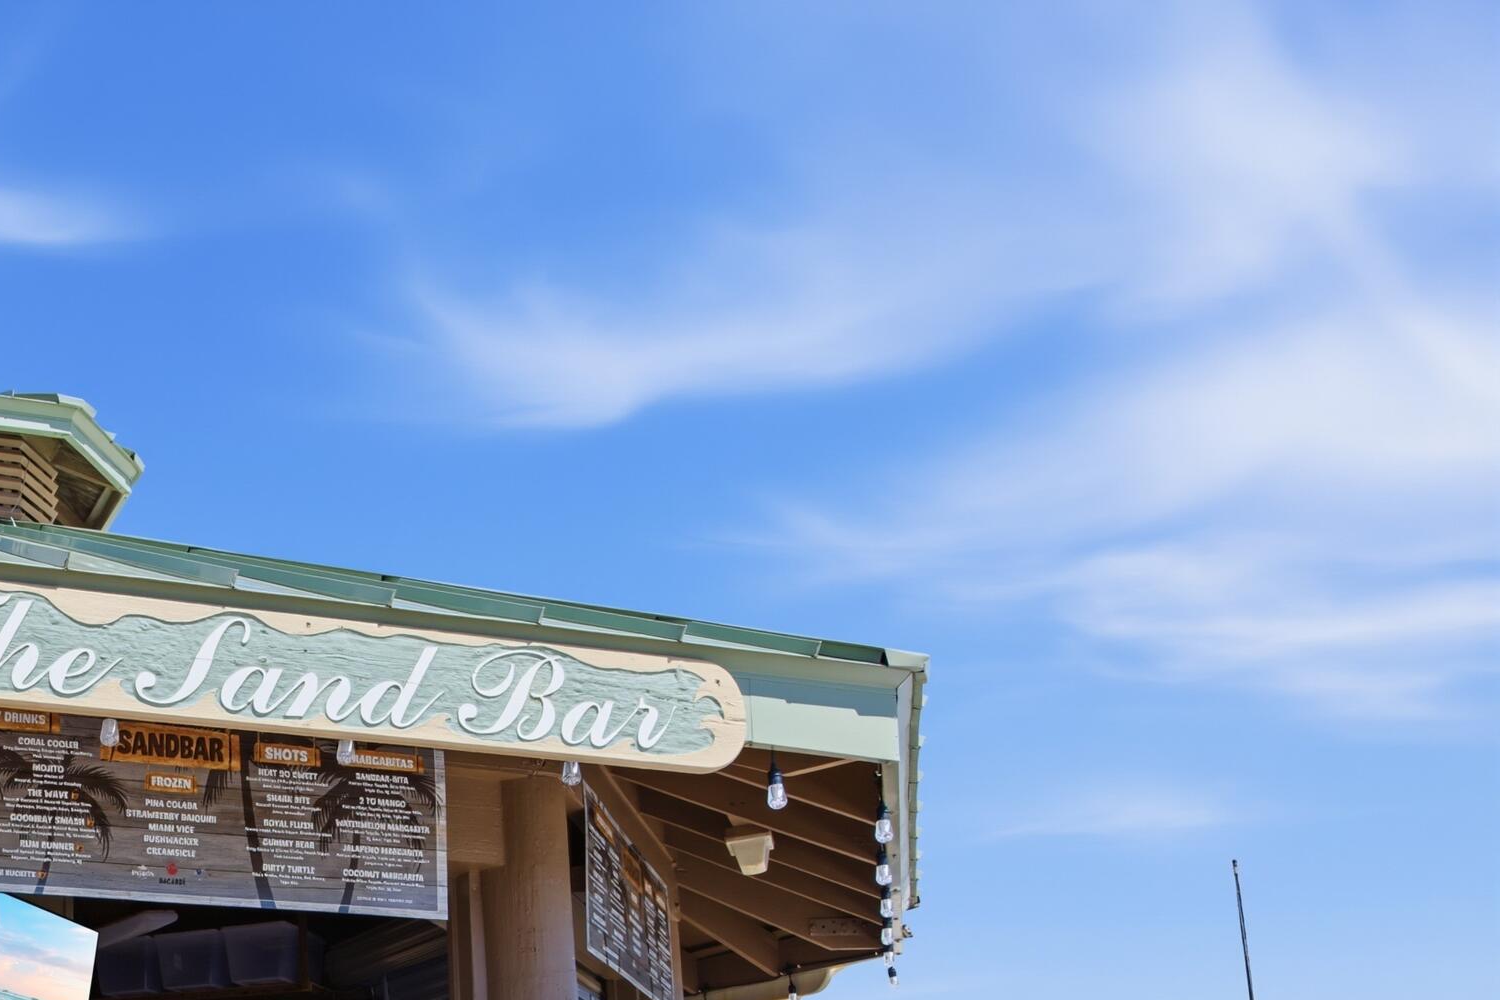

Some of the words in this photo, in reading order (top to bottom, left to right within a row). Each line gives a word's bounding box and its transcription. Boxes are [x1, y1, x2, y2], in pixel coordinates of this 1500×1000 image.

[135, 617, 445, 728] Sand
[458, 649, 676, 750] Bar
[4, 711, 46, 726] DRINKS
[18, 737, 45, 746] CORAL
[47, 740, 79, 749] COOLER
[117, 729, 224, 762] SANDBAR
[264, 746, 308, 763] SHOTS
[32, 763, 65, 773] MOJITO
[151, 776, 192, 789] FROZEN
[28, 789, 43, 797] THE
[44, 790, 69, 799] WAVE
[266, 794, 293, 803] SHARK
[294, 796, 311, 805] BITE
[166, 800, 198, 810] COLADA
[378, 799, 406, 808] MANGO
[126, 809, 179, 821] STRAWBERRY
[55, 816, 85, 826] SMASH
[263, 819, 289, 829] ROYAL
[290, 820, 314, 830] FLUSH
[335, 819, 387, 831] WATERMELON
[148, 823, 175, 833] MIAMI
[177, 825, 196, 834] VICE
[20, 840, 39, 849] RUM
[41, 841, 75, 851] RUNNER
[144, 835, 199, 847] BUSHWACKER
[262, 838, 294, 848] GUMMY
[295, 841, 315, 849] BEAR
[147, 847, 197, 858] CREAMSICLE
[263, 864, 286, 873] DIRTY
[287, 866, 316, 875] TURTLE
[343, 869, 380, 879] COCONUT
